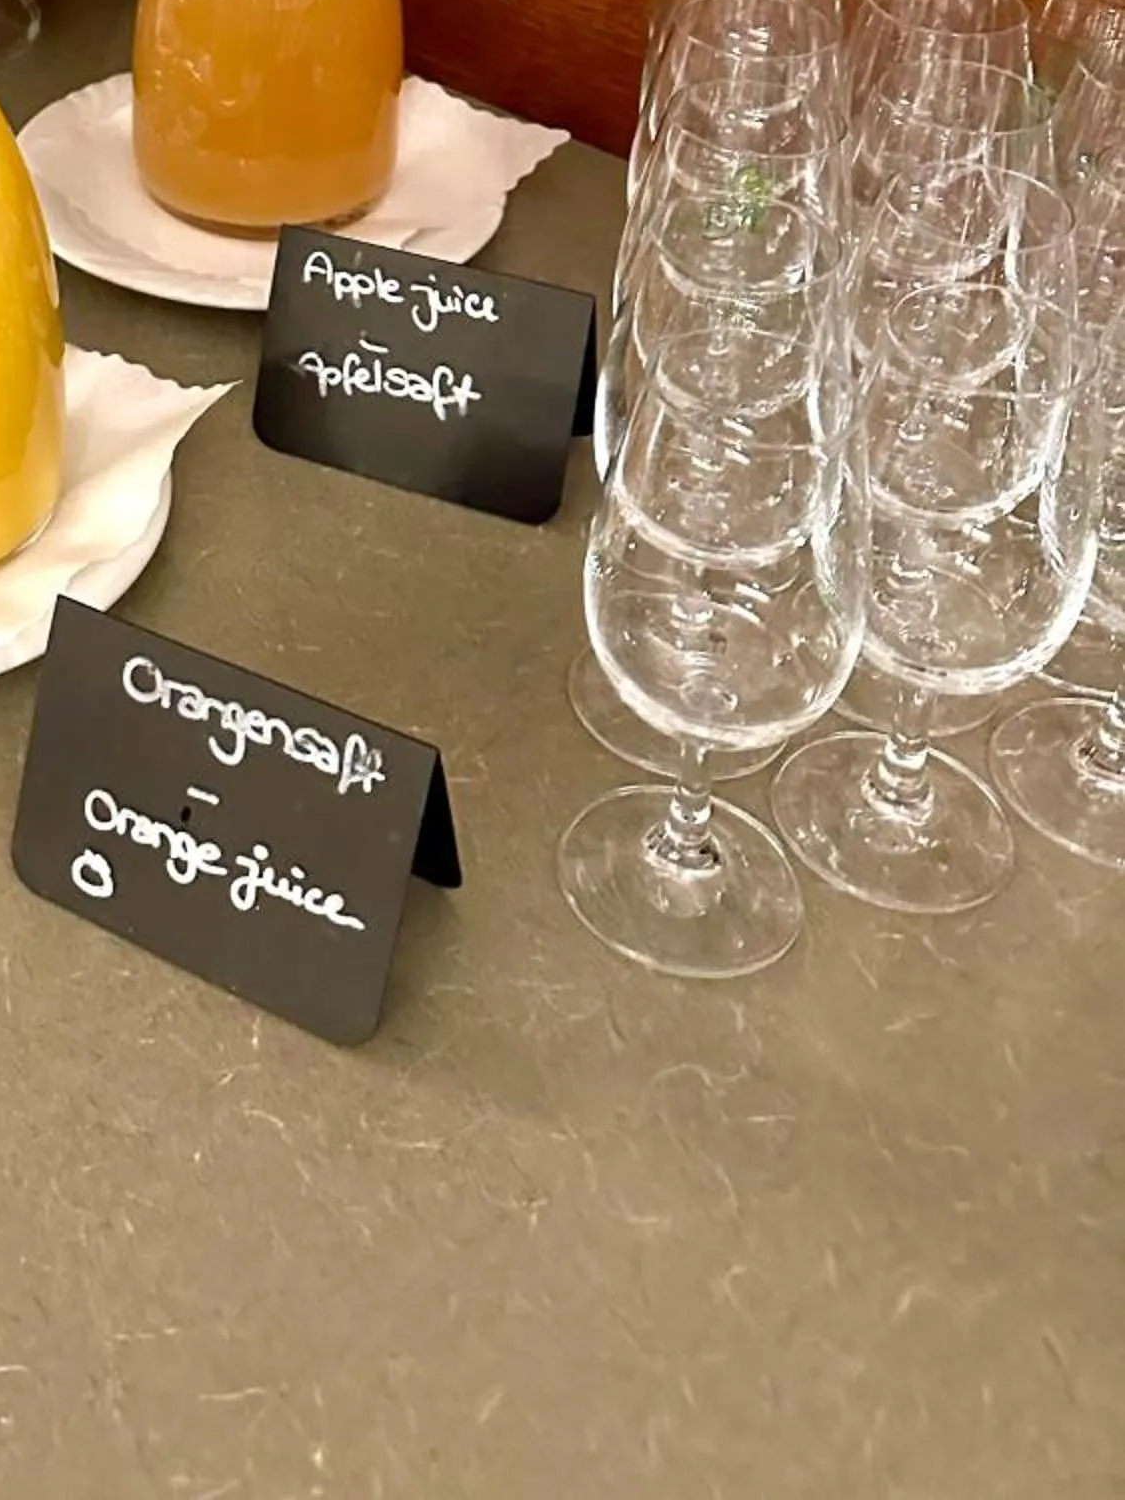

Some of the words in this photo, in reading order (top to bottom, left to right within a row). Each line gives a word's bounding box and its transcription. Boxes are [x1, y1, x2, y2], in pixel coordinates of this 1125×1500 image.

[303, 251, 405, 303] Apple
[410, 275, 500, 332] juice
[122, 656, 386, 795] Orangensaft
[84, 788, 228, 885] Orange
[229, 844, 366, 931] juice
